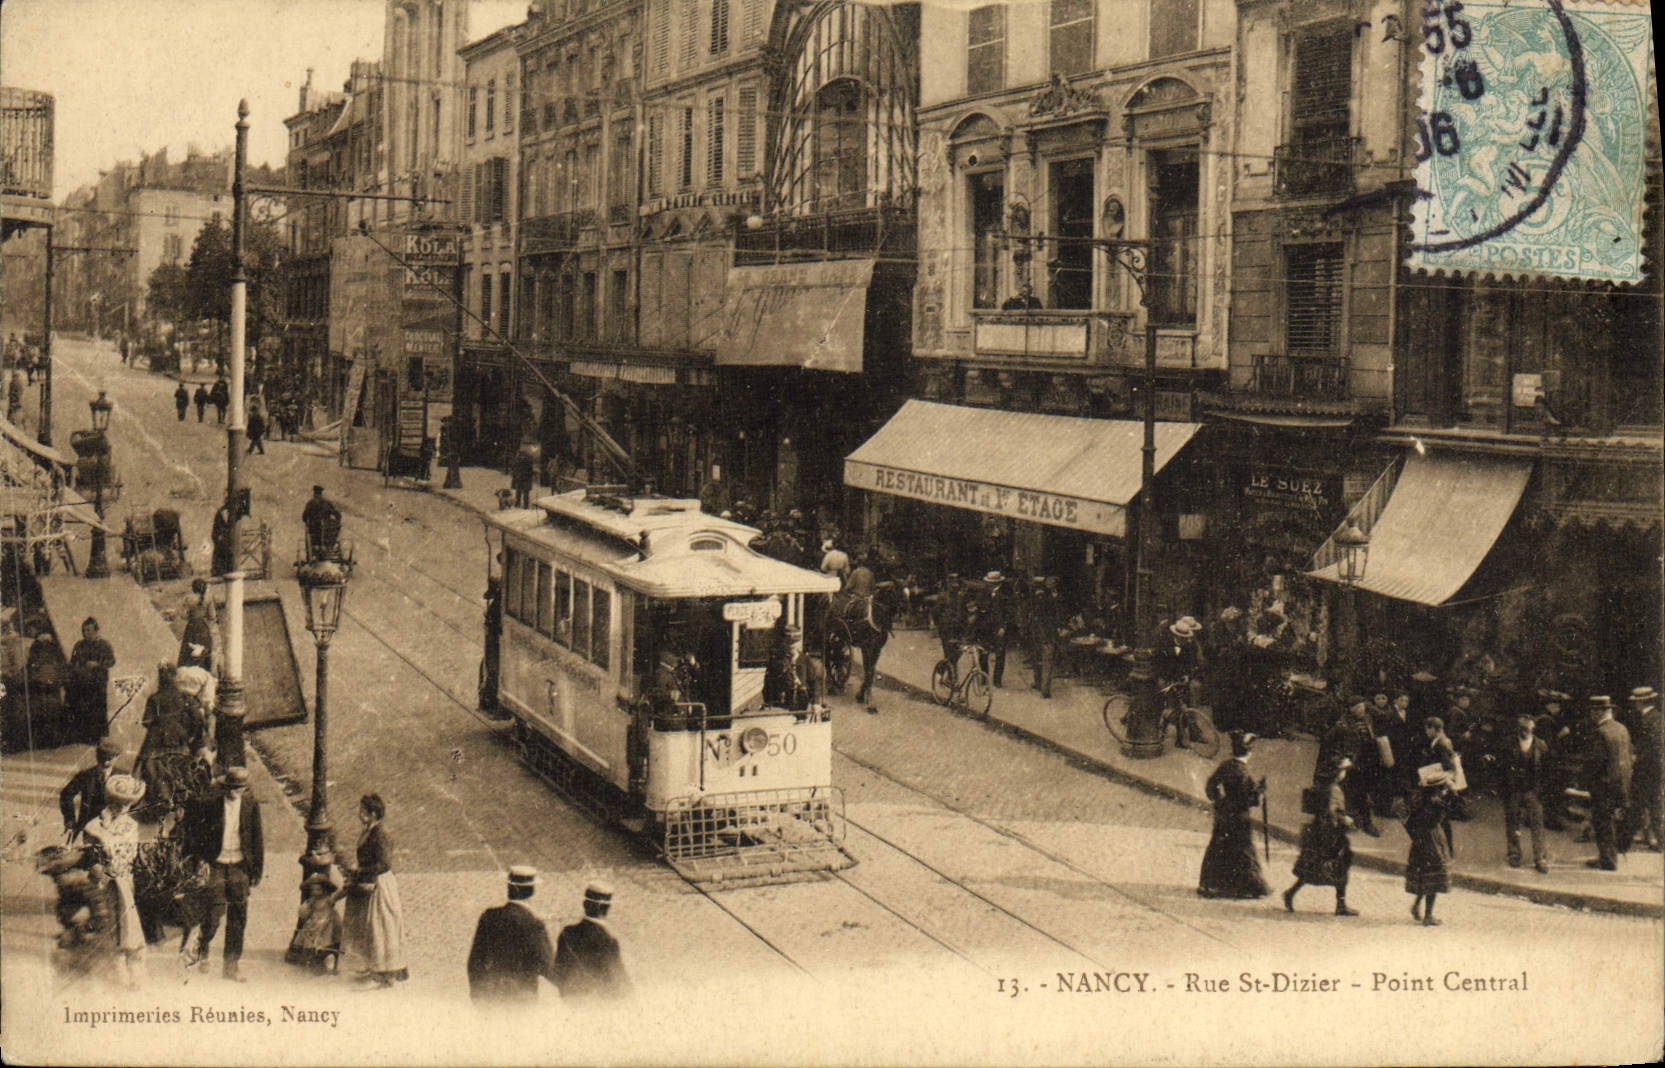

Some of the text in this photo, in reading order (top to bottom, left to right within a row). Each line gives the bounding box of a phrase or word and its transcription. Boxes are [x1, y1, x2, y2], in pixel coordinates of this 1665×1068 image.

[407, 234, 457, 255] KOLA
[1486, 244, 1577, 271] POSTES
[875, 469, 979, 505] RESTAURANT
[1251, 474, 1323, 495] LE SUEZ
